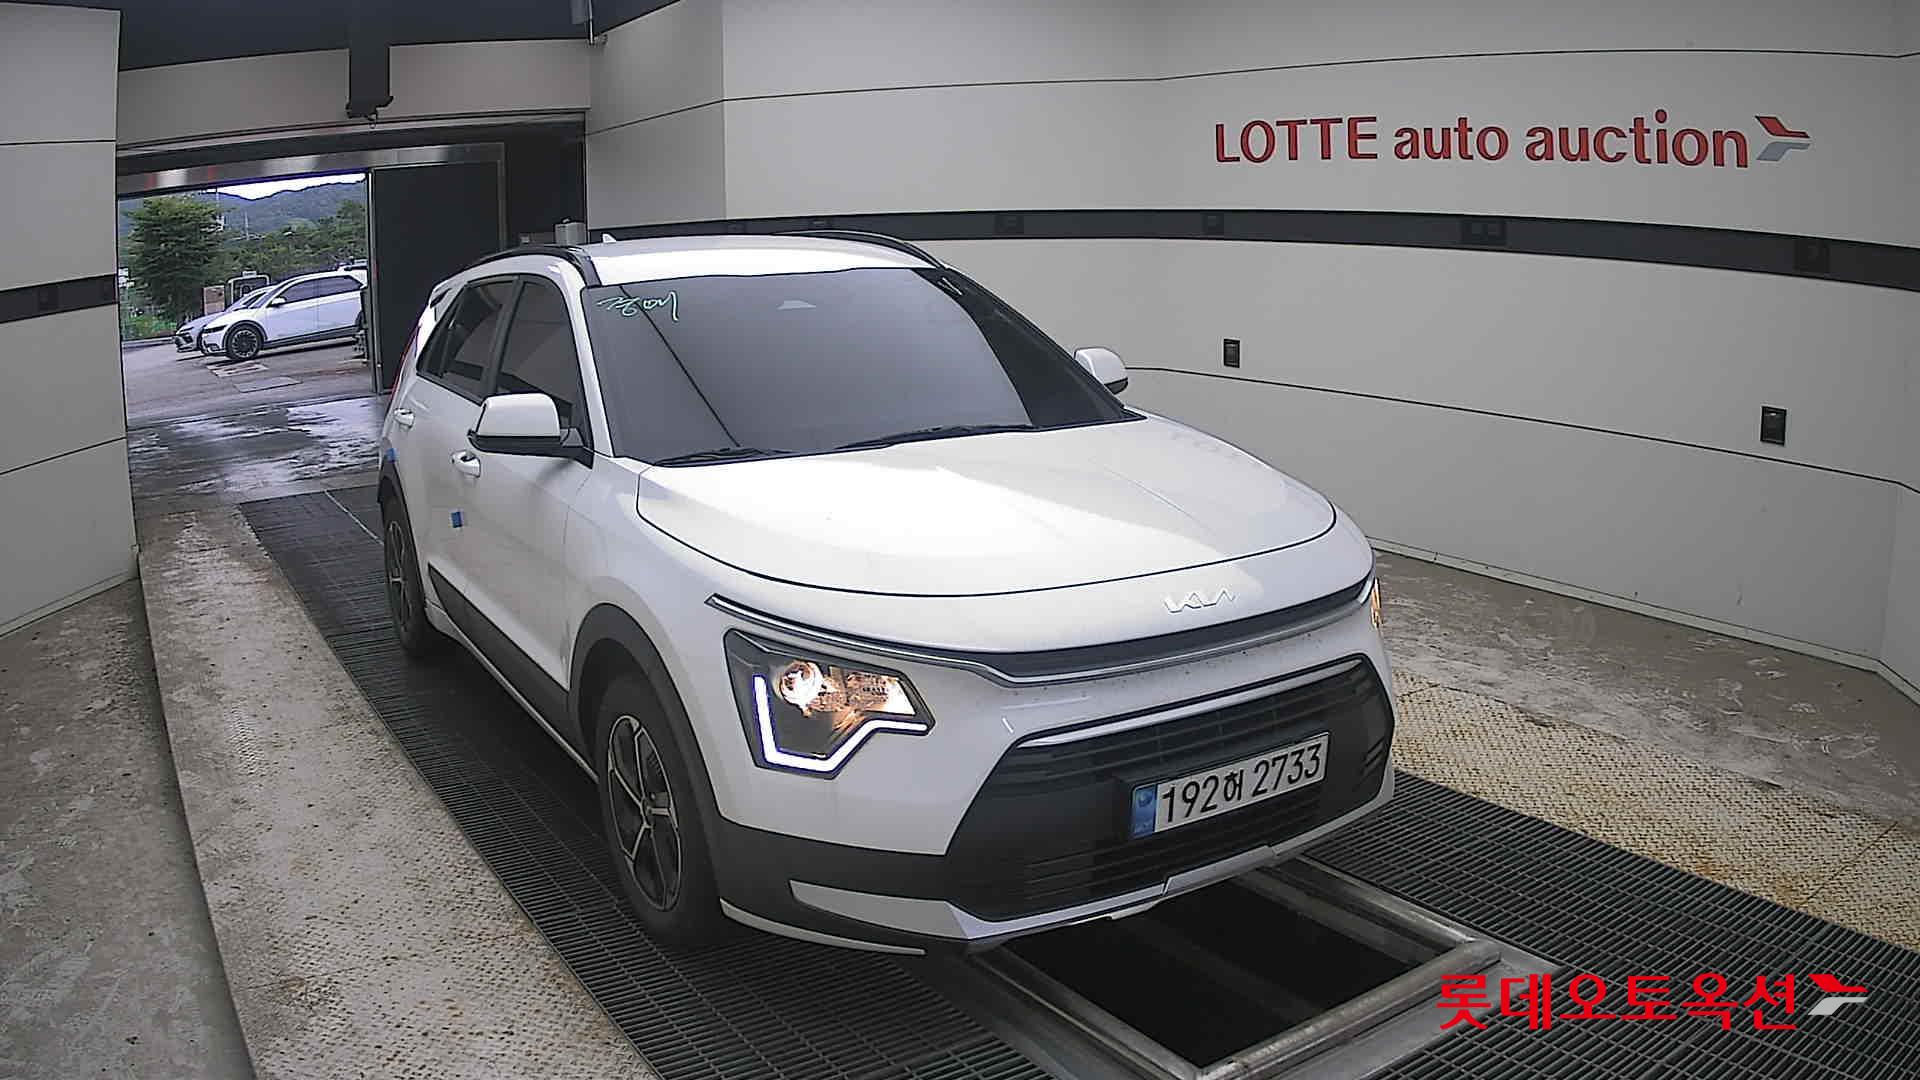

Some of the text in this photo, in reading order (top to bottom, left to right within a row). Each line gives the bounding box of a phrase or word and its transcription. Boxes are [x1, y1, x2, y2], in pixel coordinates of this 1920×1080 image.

[1215, 108, 1748, 169] LOTTE auto auction
[1162, 742, 1322, 822] 192허 2733
